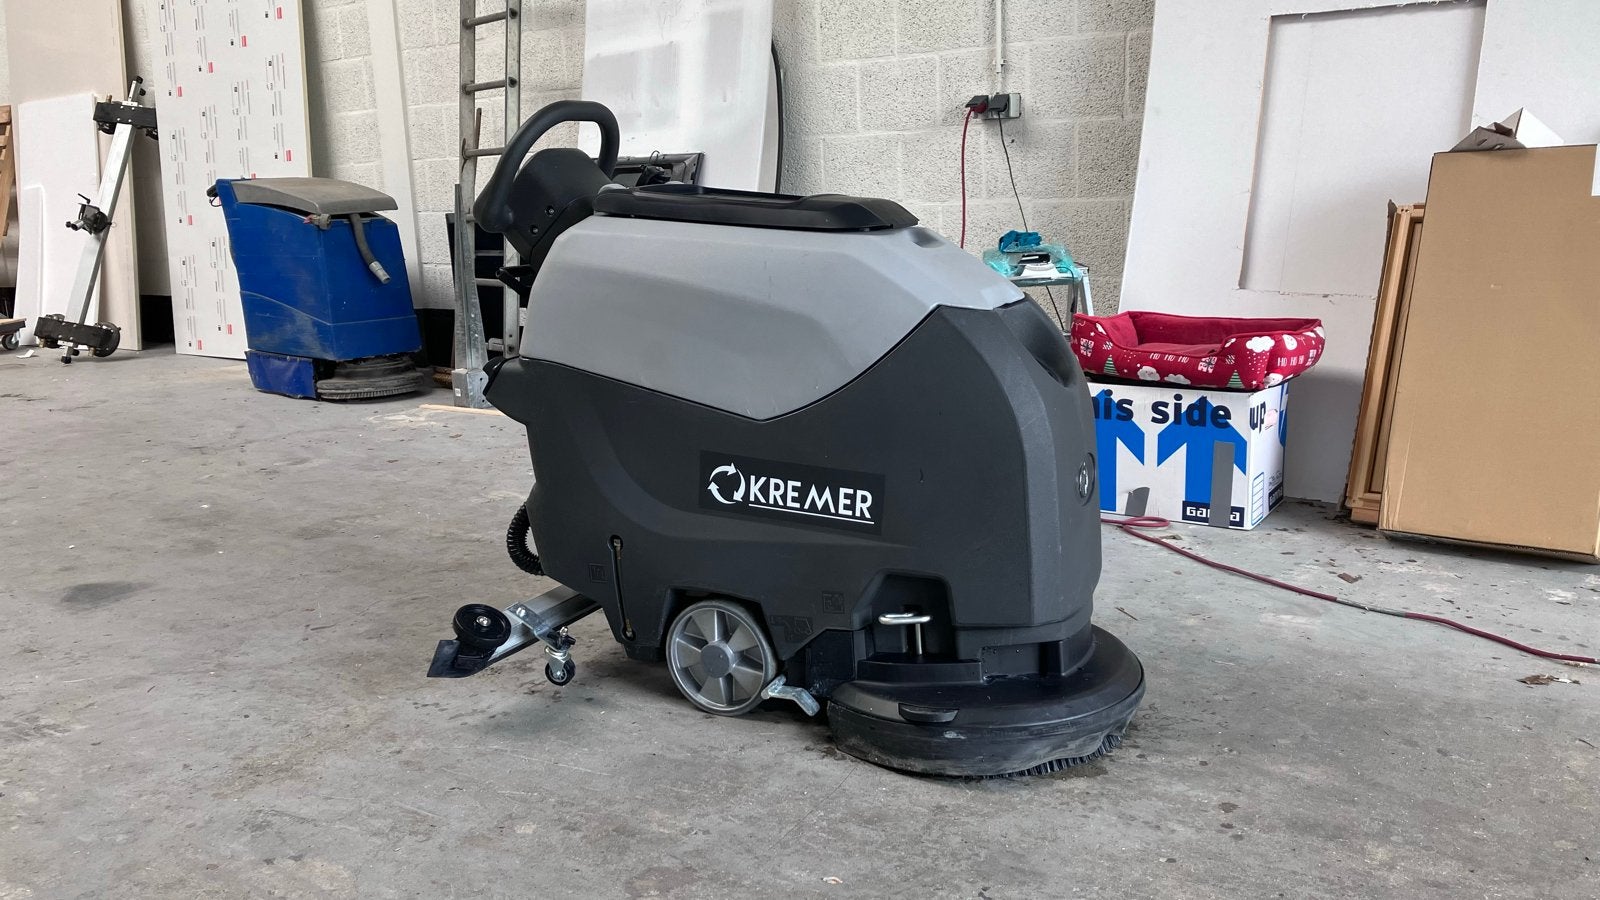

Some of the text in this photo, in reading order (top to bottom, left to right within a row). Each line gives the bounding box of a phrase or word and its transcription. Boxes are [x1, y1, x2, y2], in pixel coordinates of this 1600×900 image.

[1277, 357, 1288, 367] HO
[1091, 389, 1266, 433] is side up
[749, 474, 873, 519] KREMER
